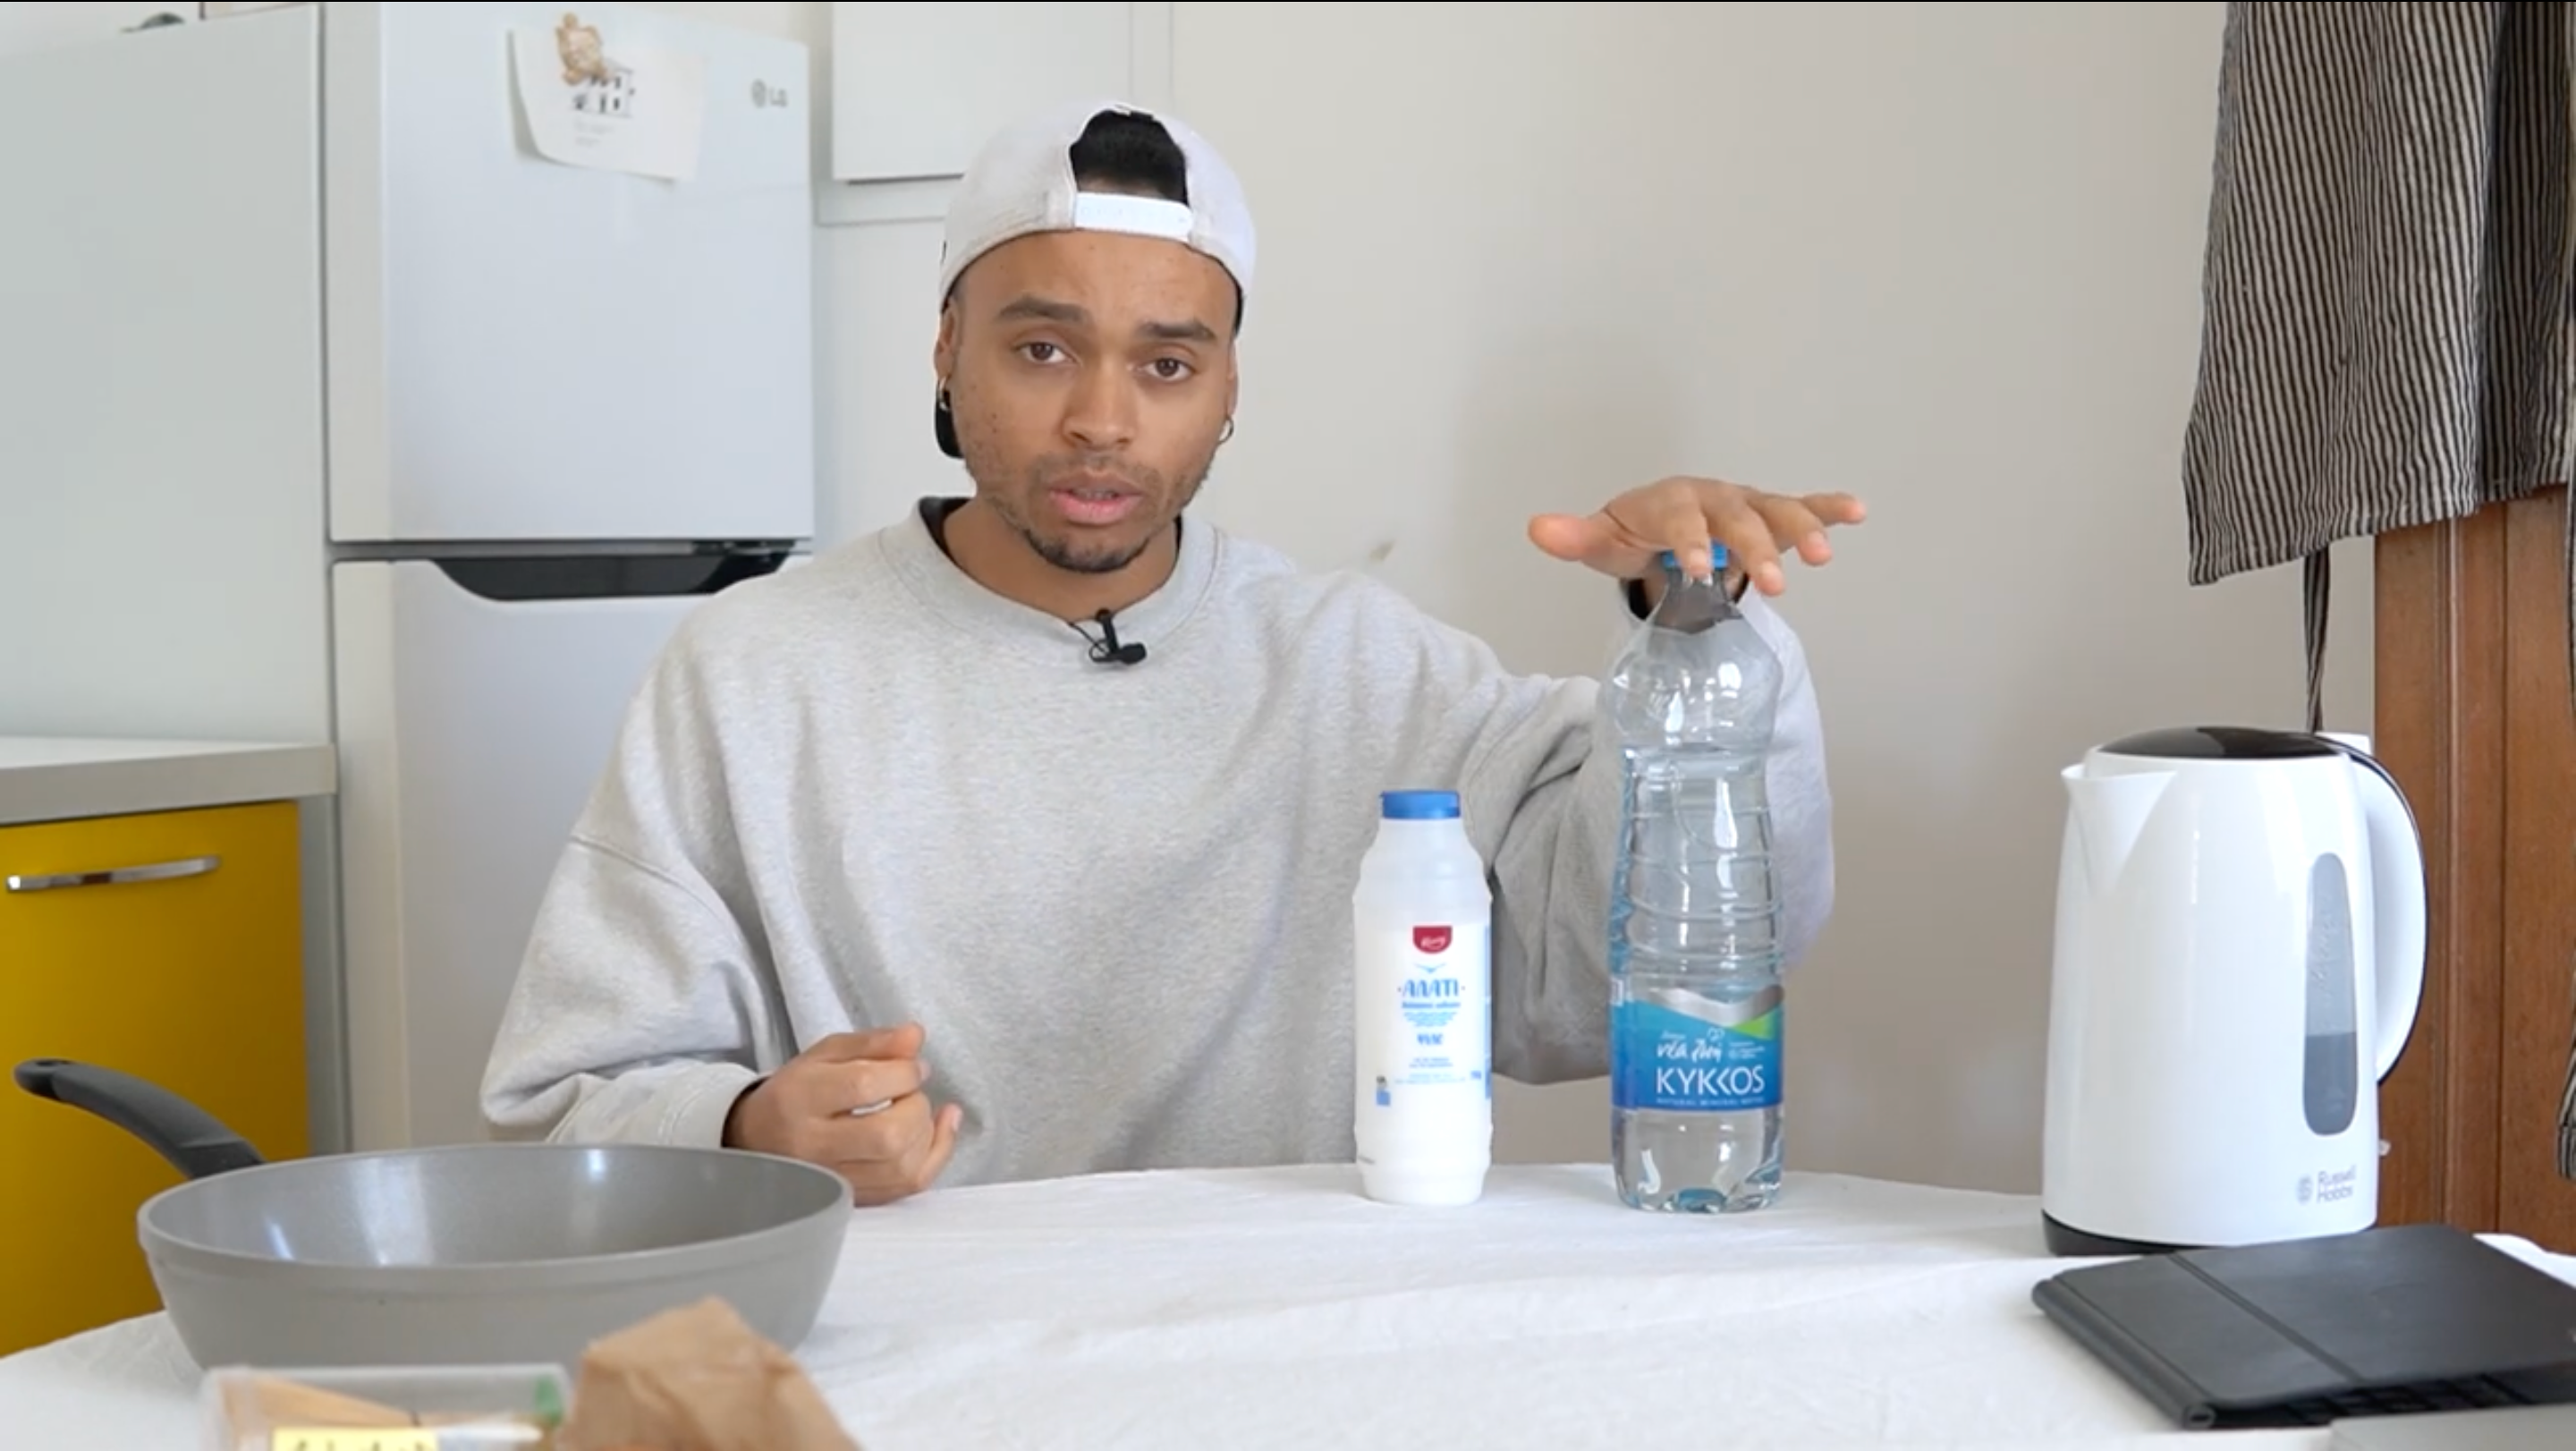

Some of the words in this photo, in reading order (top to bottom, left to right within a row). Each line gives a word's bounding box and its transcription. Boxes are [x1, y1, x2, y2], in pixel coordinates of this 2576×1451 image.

[768, 86, 789, 108] LG
[2317, 1164, 2357, 1185] Russell
[2316, 1184, 2353, 1204] Hobbs
